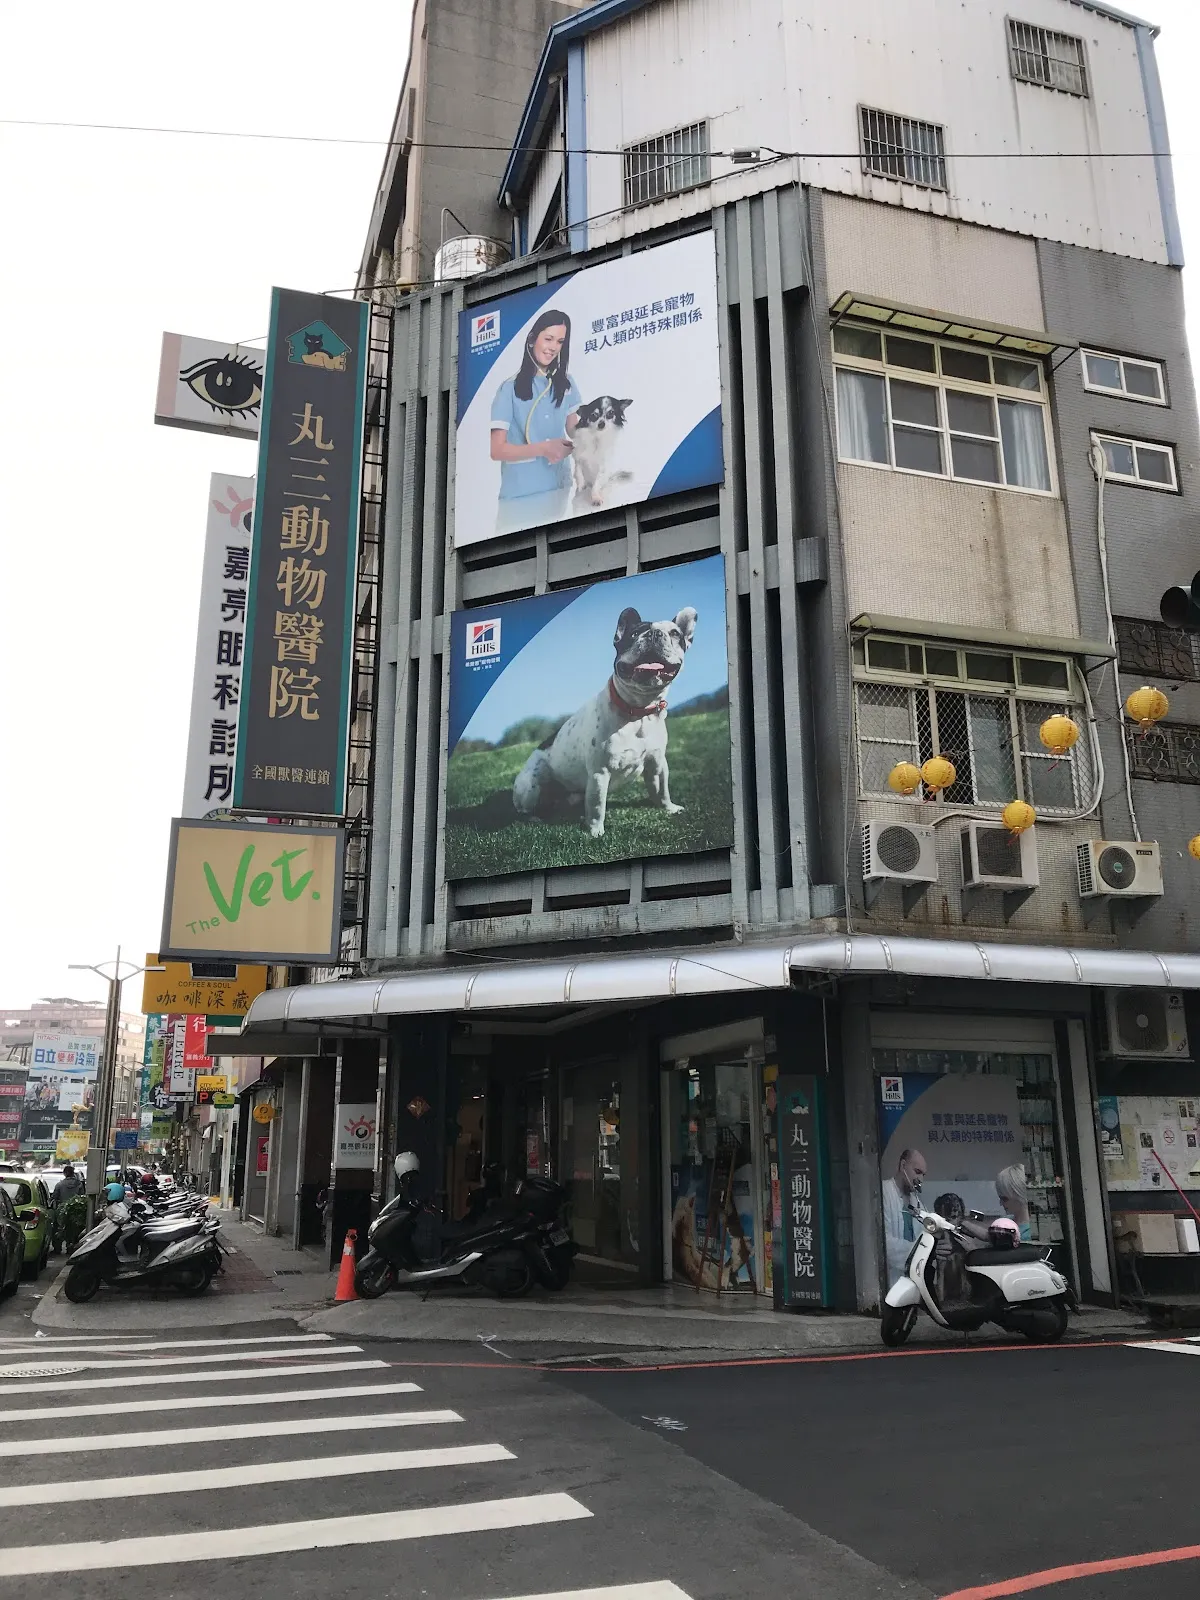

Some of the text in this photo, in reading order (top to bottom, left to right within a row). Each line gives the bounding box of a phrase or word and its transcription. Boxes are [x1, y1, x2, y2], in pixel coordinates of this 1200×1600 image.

[591, 291, 695, 335] 豐富與延長寵物
[584, 308, 703, 355] 與人類的特殊關係
[268, 402, 335, 722] 丸三動物醫院
[471, 642, 496, 655] Hill's
[251, 764, 331, 786] 全國獸醫連鎖
[186, 844, 320, 935] The Vet.
[156, 989, 250, 1011] 咖啡深藏
[199, 1092, 209, 1103] P
[932, 1113, 1008, 1126] 豐富與延長寵物
[928, 1130, 1015, 1143] 與人類的特殊關係
[790, 1123, 815, 1278] 丸三動物醫院
